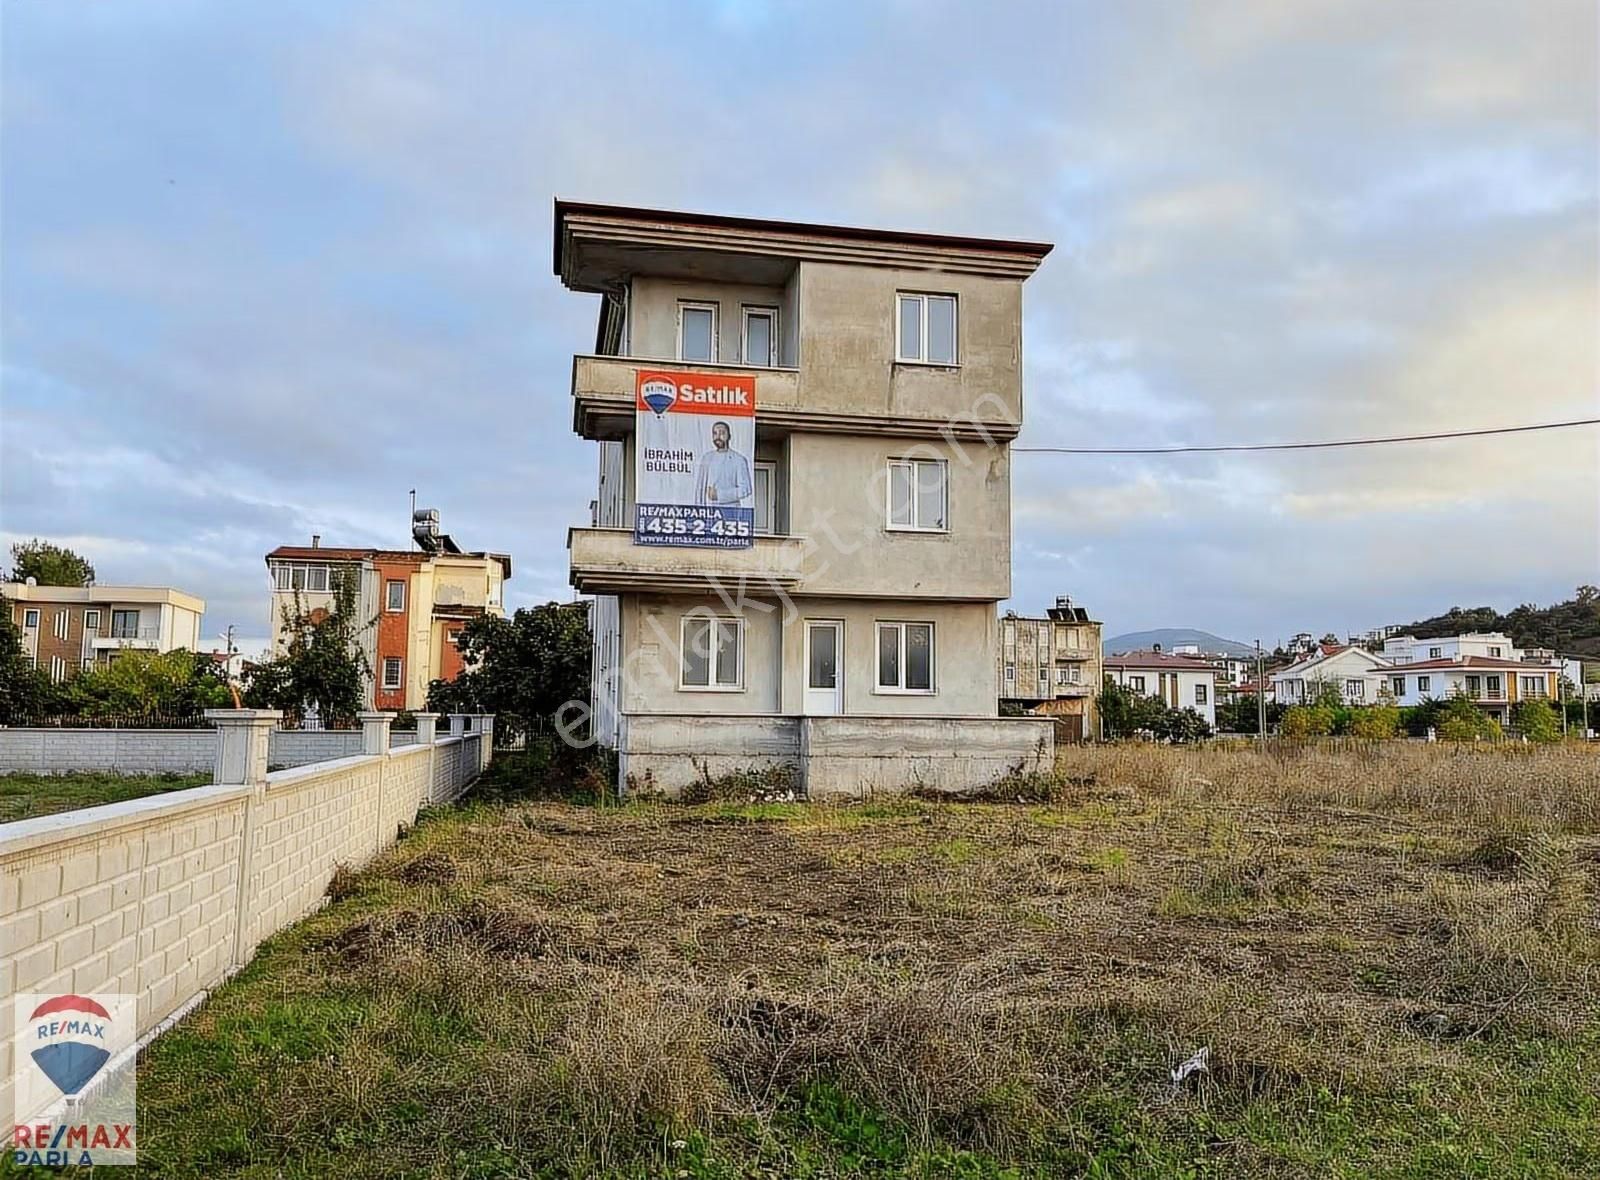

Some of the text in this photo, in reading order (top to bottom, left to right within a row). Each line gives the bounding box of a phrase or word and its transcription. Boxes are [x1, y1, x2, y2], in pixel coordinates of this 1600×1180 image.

[680, 384, 749, 405] Satılık
[644, 448, 693, 461] İBRAHİM
[646, 461, 692, 473] BÜLBÜL
[647, 518, 686, 535] 435
[692, 519, 706, 535] 2
[711, 521, 749, 537] 435
